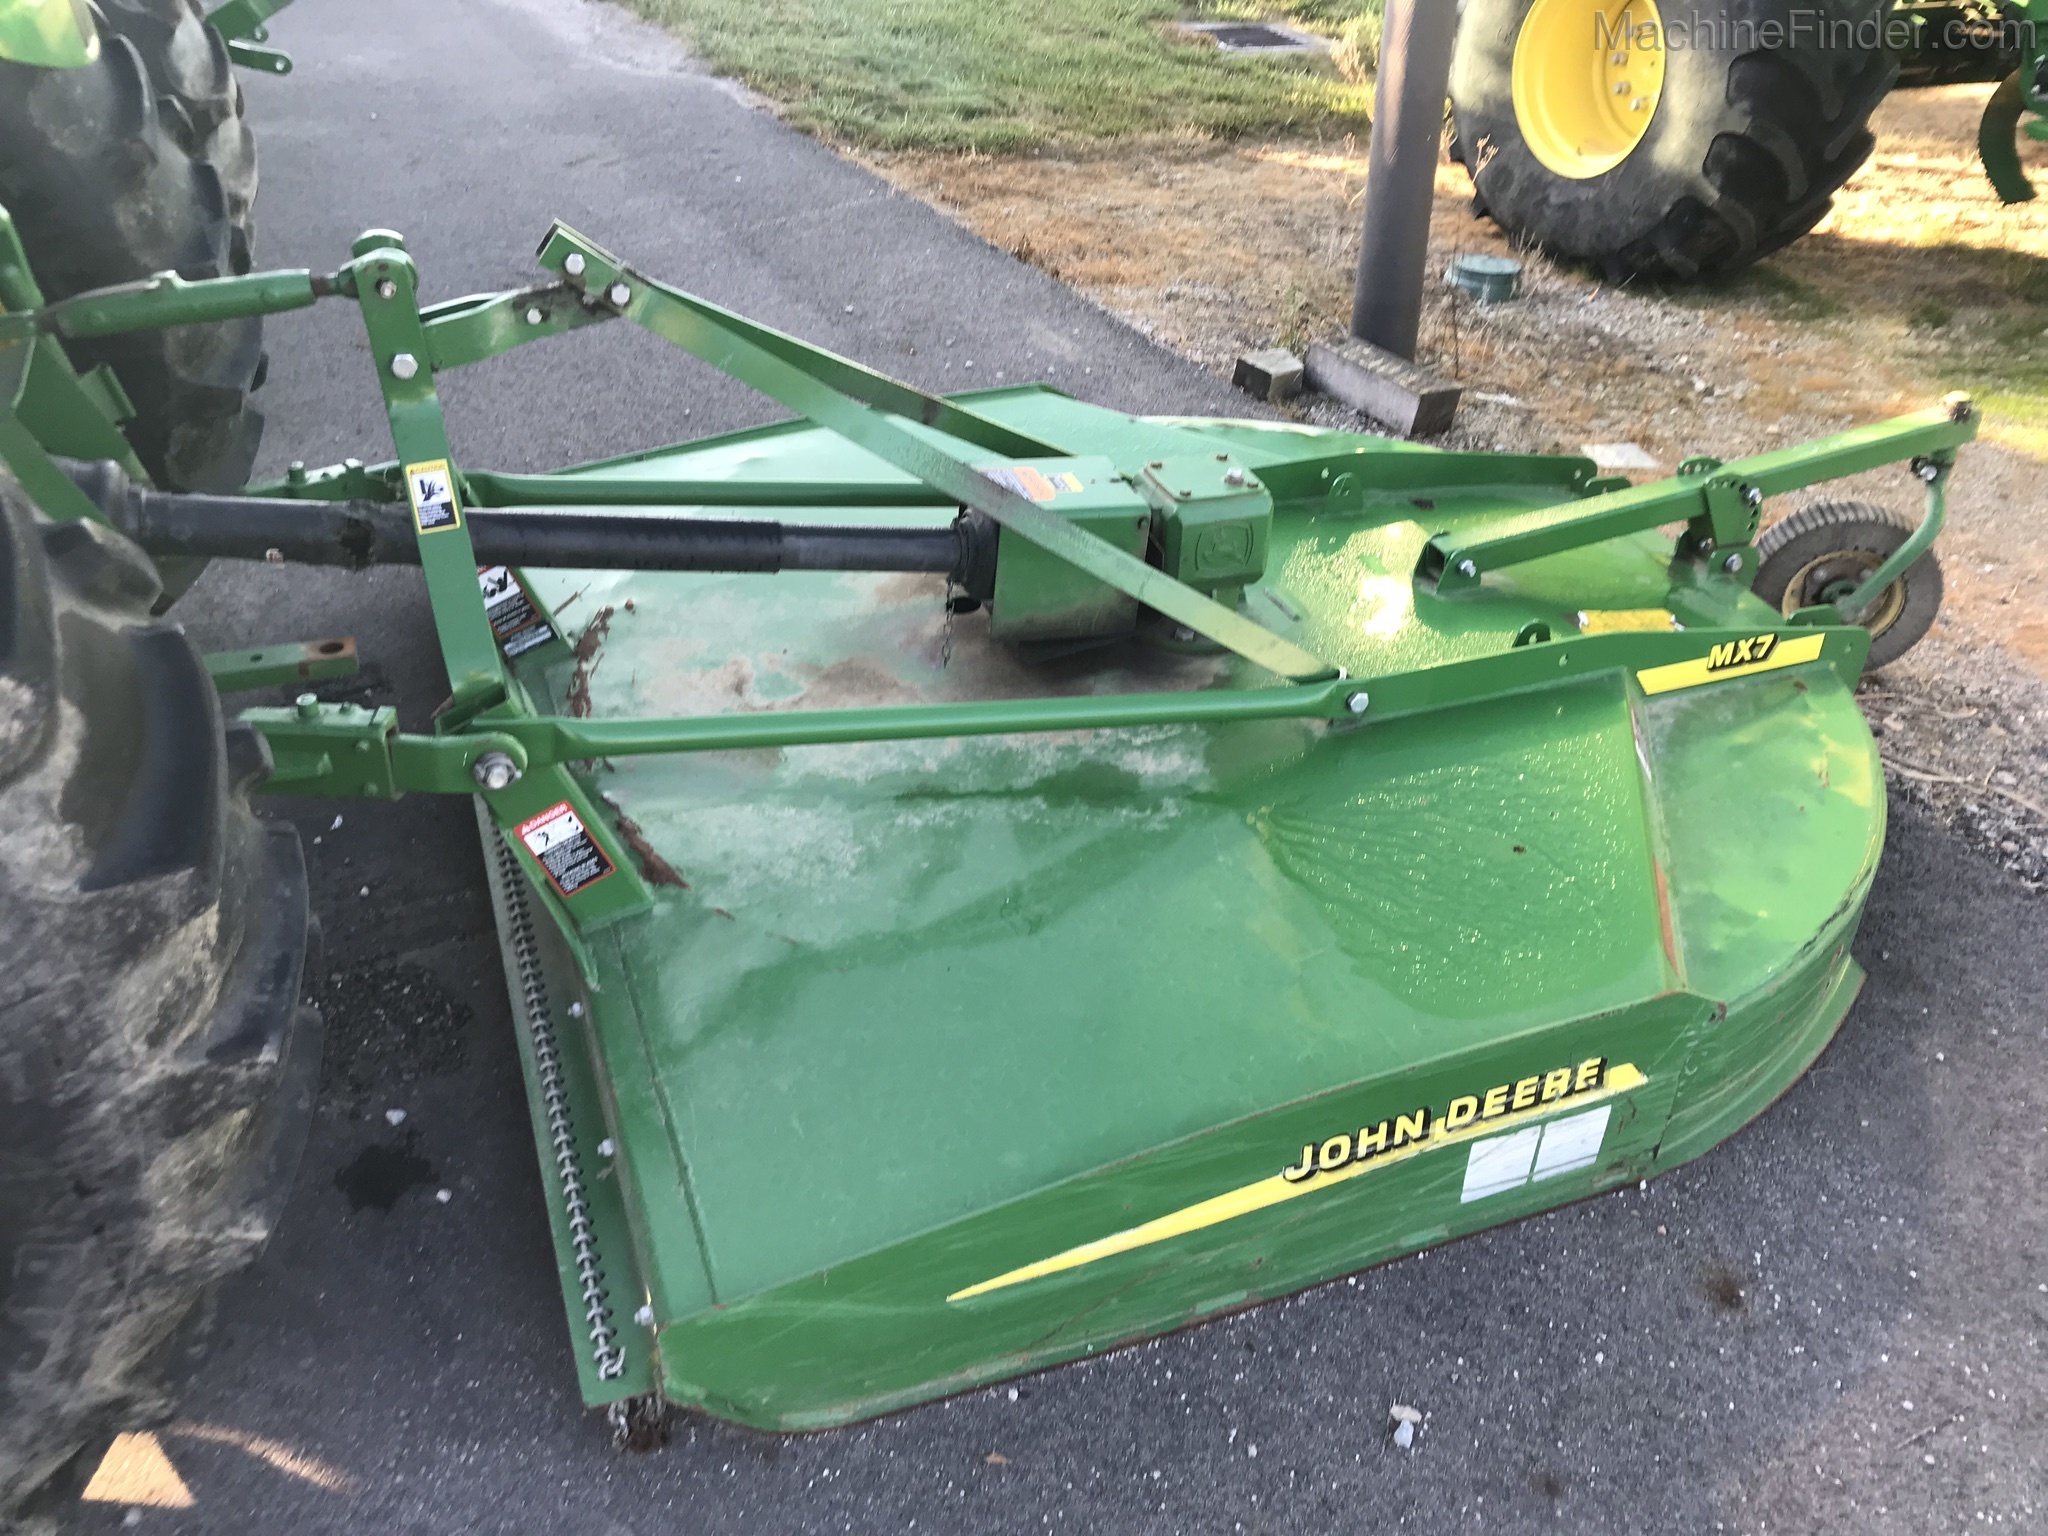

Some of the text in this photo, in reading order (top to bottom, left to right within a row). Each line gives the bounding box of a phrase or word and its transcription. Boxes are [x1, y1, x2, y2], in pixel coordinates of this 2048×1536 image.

[1706, 632, 1779, 672] MX7
[530, 803, 568, 830] DANGER
[1283, 1056, 1607, 1183] JOHN DEERE
